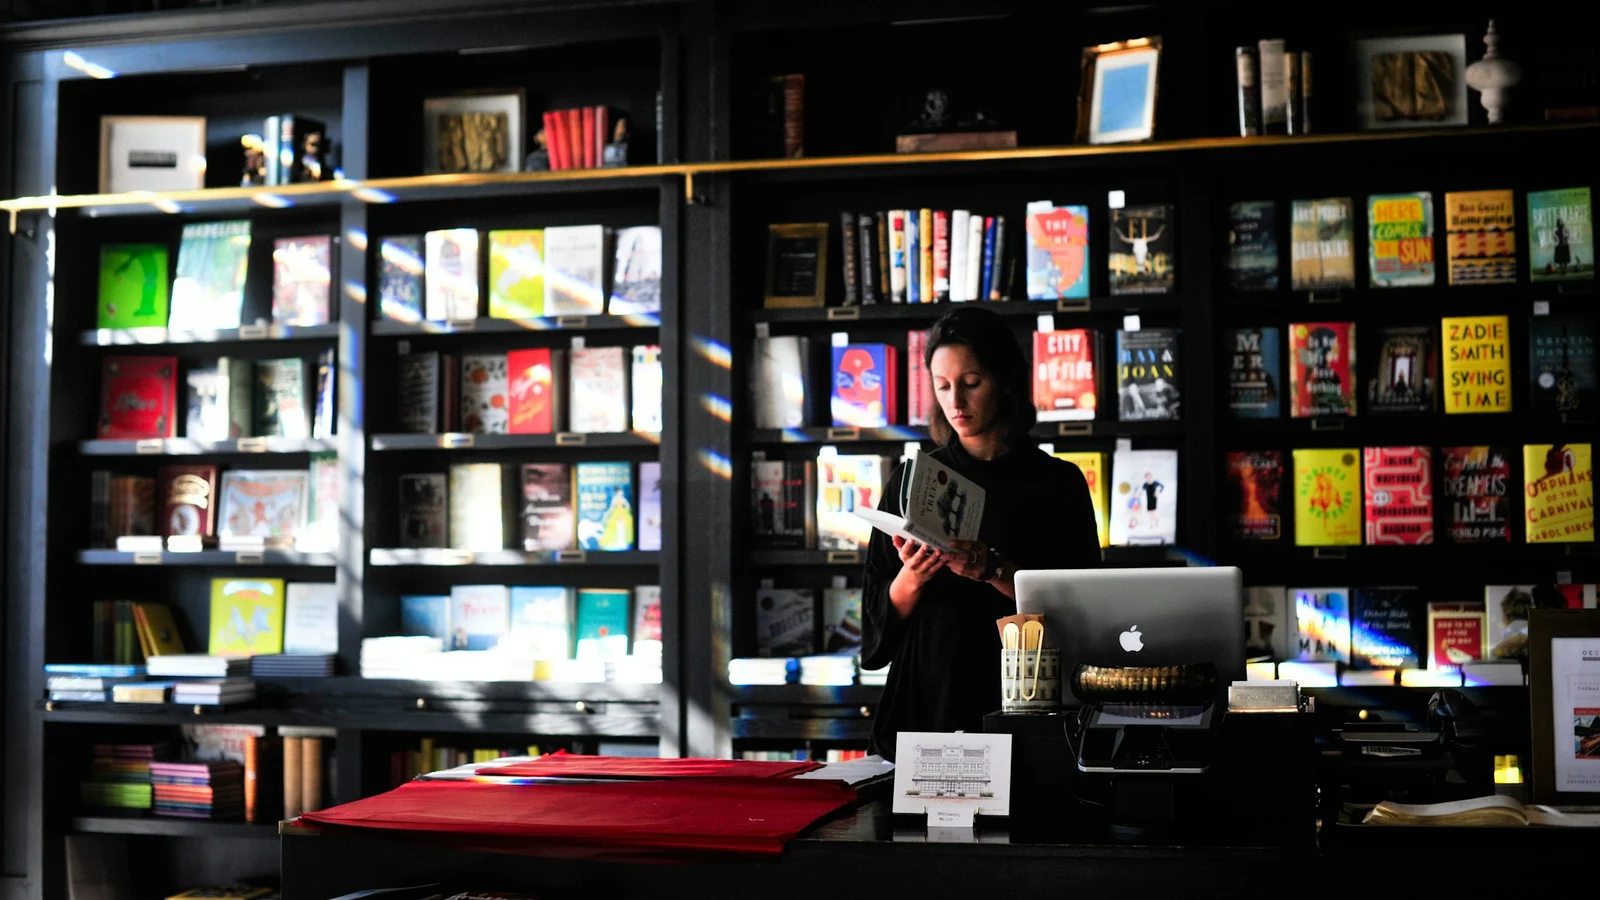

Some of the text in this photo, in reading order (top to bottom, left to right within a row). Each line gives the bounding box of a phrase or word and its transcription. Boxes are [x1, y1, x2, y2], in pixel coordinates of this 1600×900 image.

[1377, 200, 1420, 221] HERE
[1452, 214, 1513, 227] Homegoing
[183, 221, 250, 239] MADELINE
[1377, 223, 1422, 239] COMES
[1401, 238, 1434, 264] SUN
[1450, 322, 1505, 341] ZADIE
[1048, 335, 1081, 354] CITY
[1451, 344, 1505, 361] SMITH
[1122, 348, 1173, 364] RAY &
[1038, 359, 1093, 381] ON FIRE
[1122, 364, 1173, 380] JOAN
[1452, 370, 1506, 387] SWING
[1306, 380, 1342, 396] Nothing
[1452, 391, 1507, 408] TIME
[1444, 473, 1507, 497] DREAMERS
[1527, 469, 1593, 498] ORPHANS
[926, 477, 938, 513] TREES
[1546, 488, 1578, 503] OF THE
[1528, 496, 1594, 523] CARNIVAL
[1529, 529, 1561, 543] CAROL
[1363, 609, 1387, 618] Other
[1386, 620, 1411, 629] World
[1299, 639, 1337, 653] MAN
